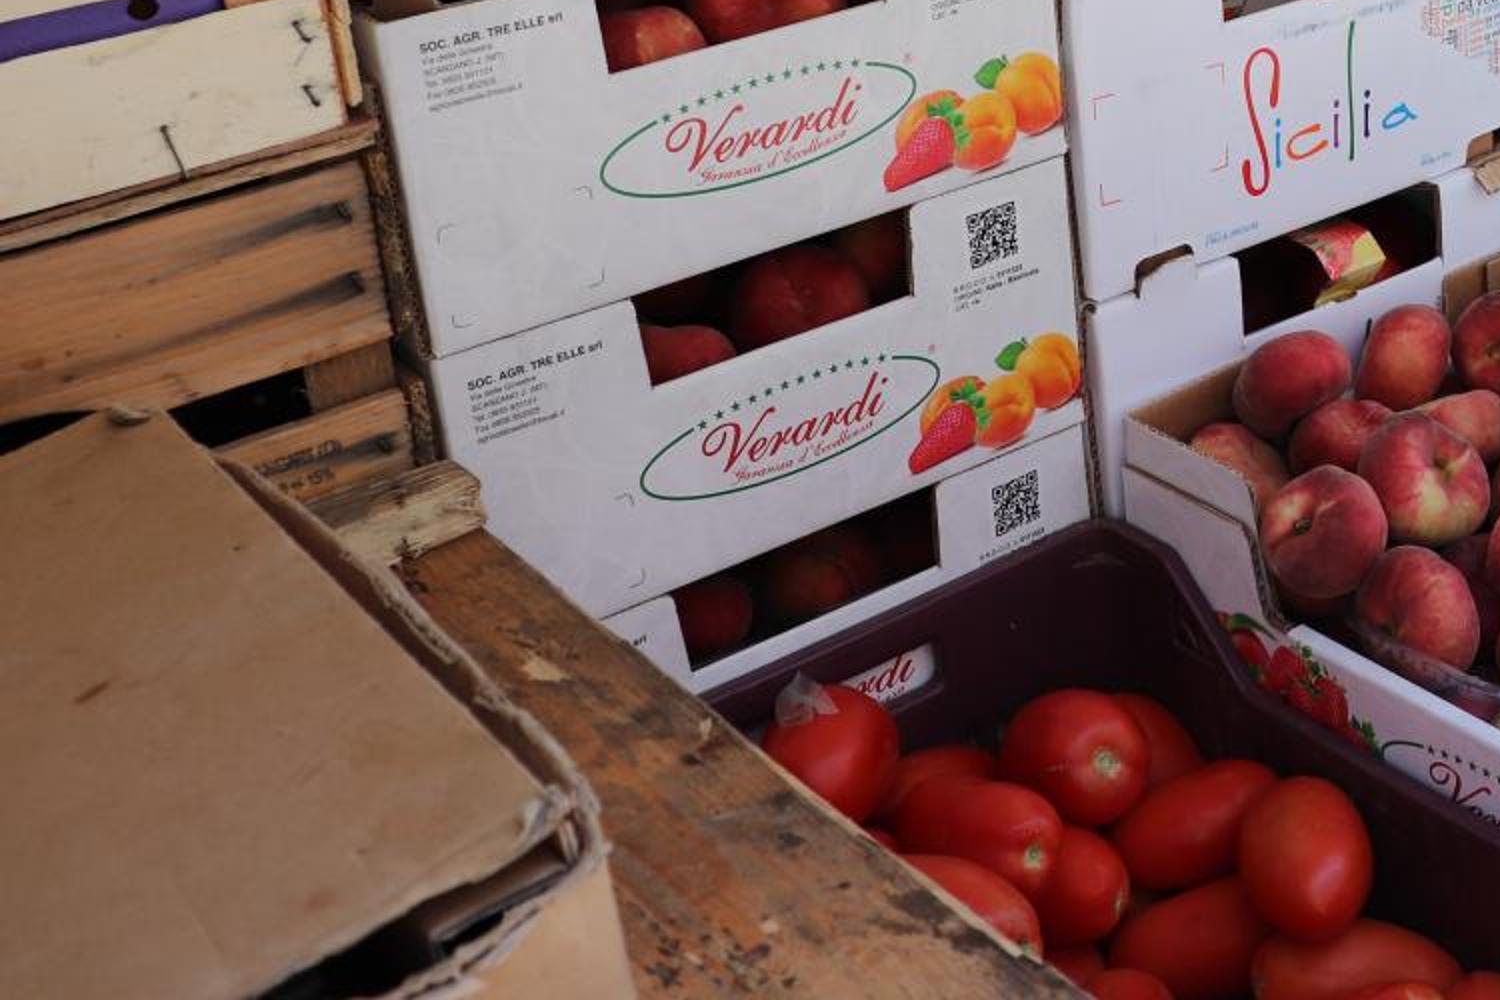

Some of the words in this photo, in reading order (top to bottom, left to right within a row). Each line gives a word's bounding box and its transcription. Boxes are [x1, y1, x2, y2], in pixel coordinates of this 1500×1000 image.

[453, 32, 481, 47] AGR.
[487, 24, 511, 38] TRE
[514, 16, 545, 31] ELLE
[665, 77, 862, 172] Verardi
[1242, 19, 1418, 197] Sicilia
[499, 365, 528, 380] AGR.
[530, 356, 554, 370] TRE
[556, 345, 586, 362] ELLE
[702, 371, 888, 473] Verardi
